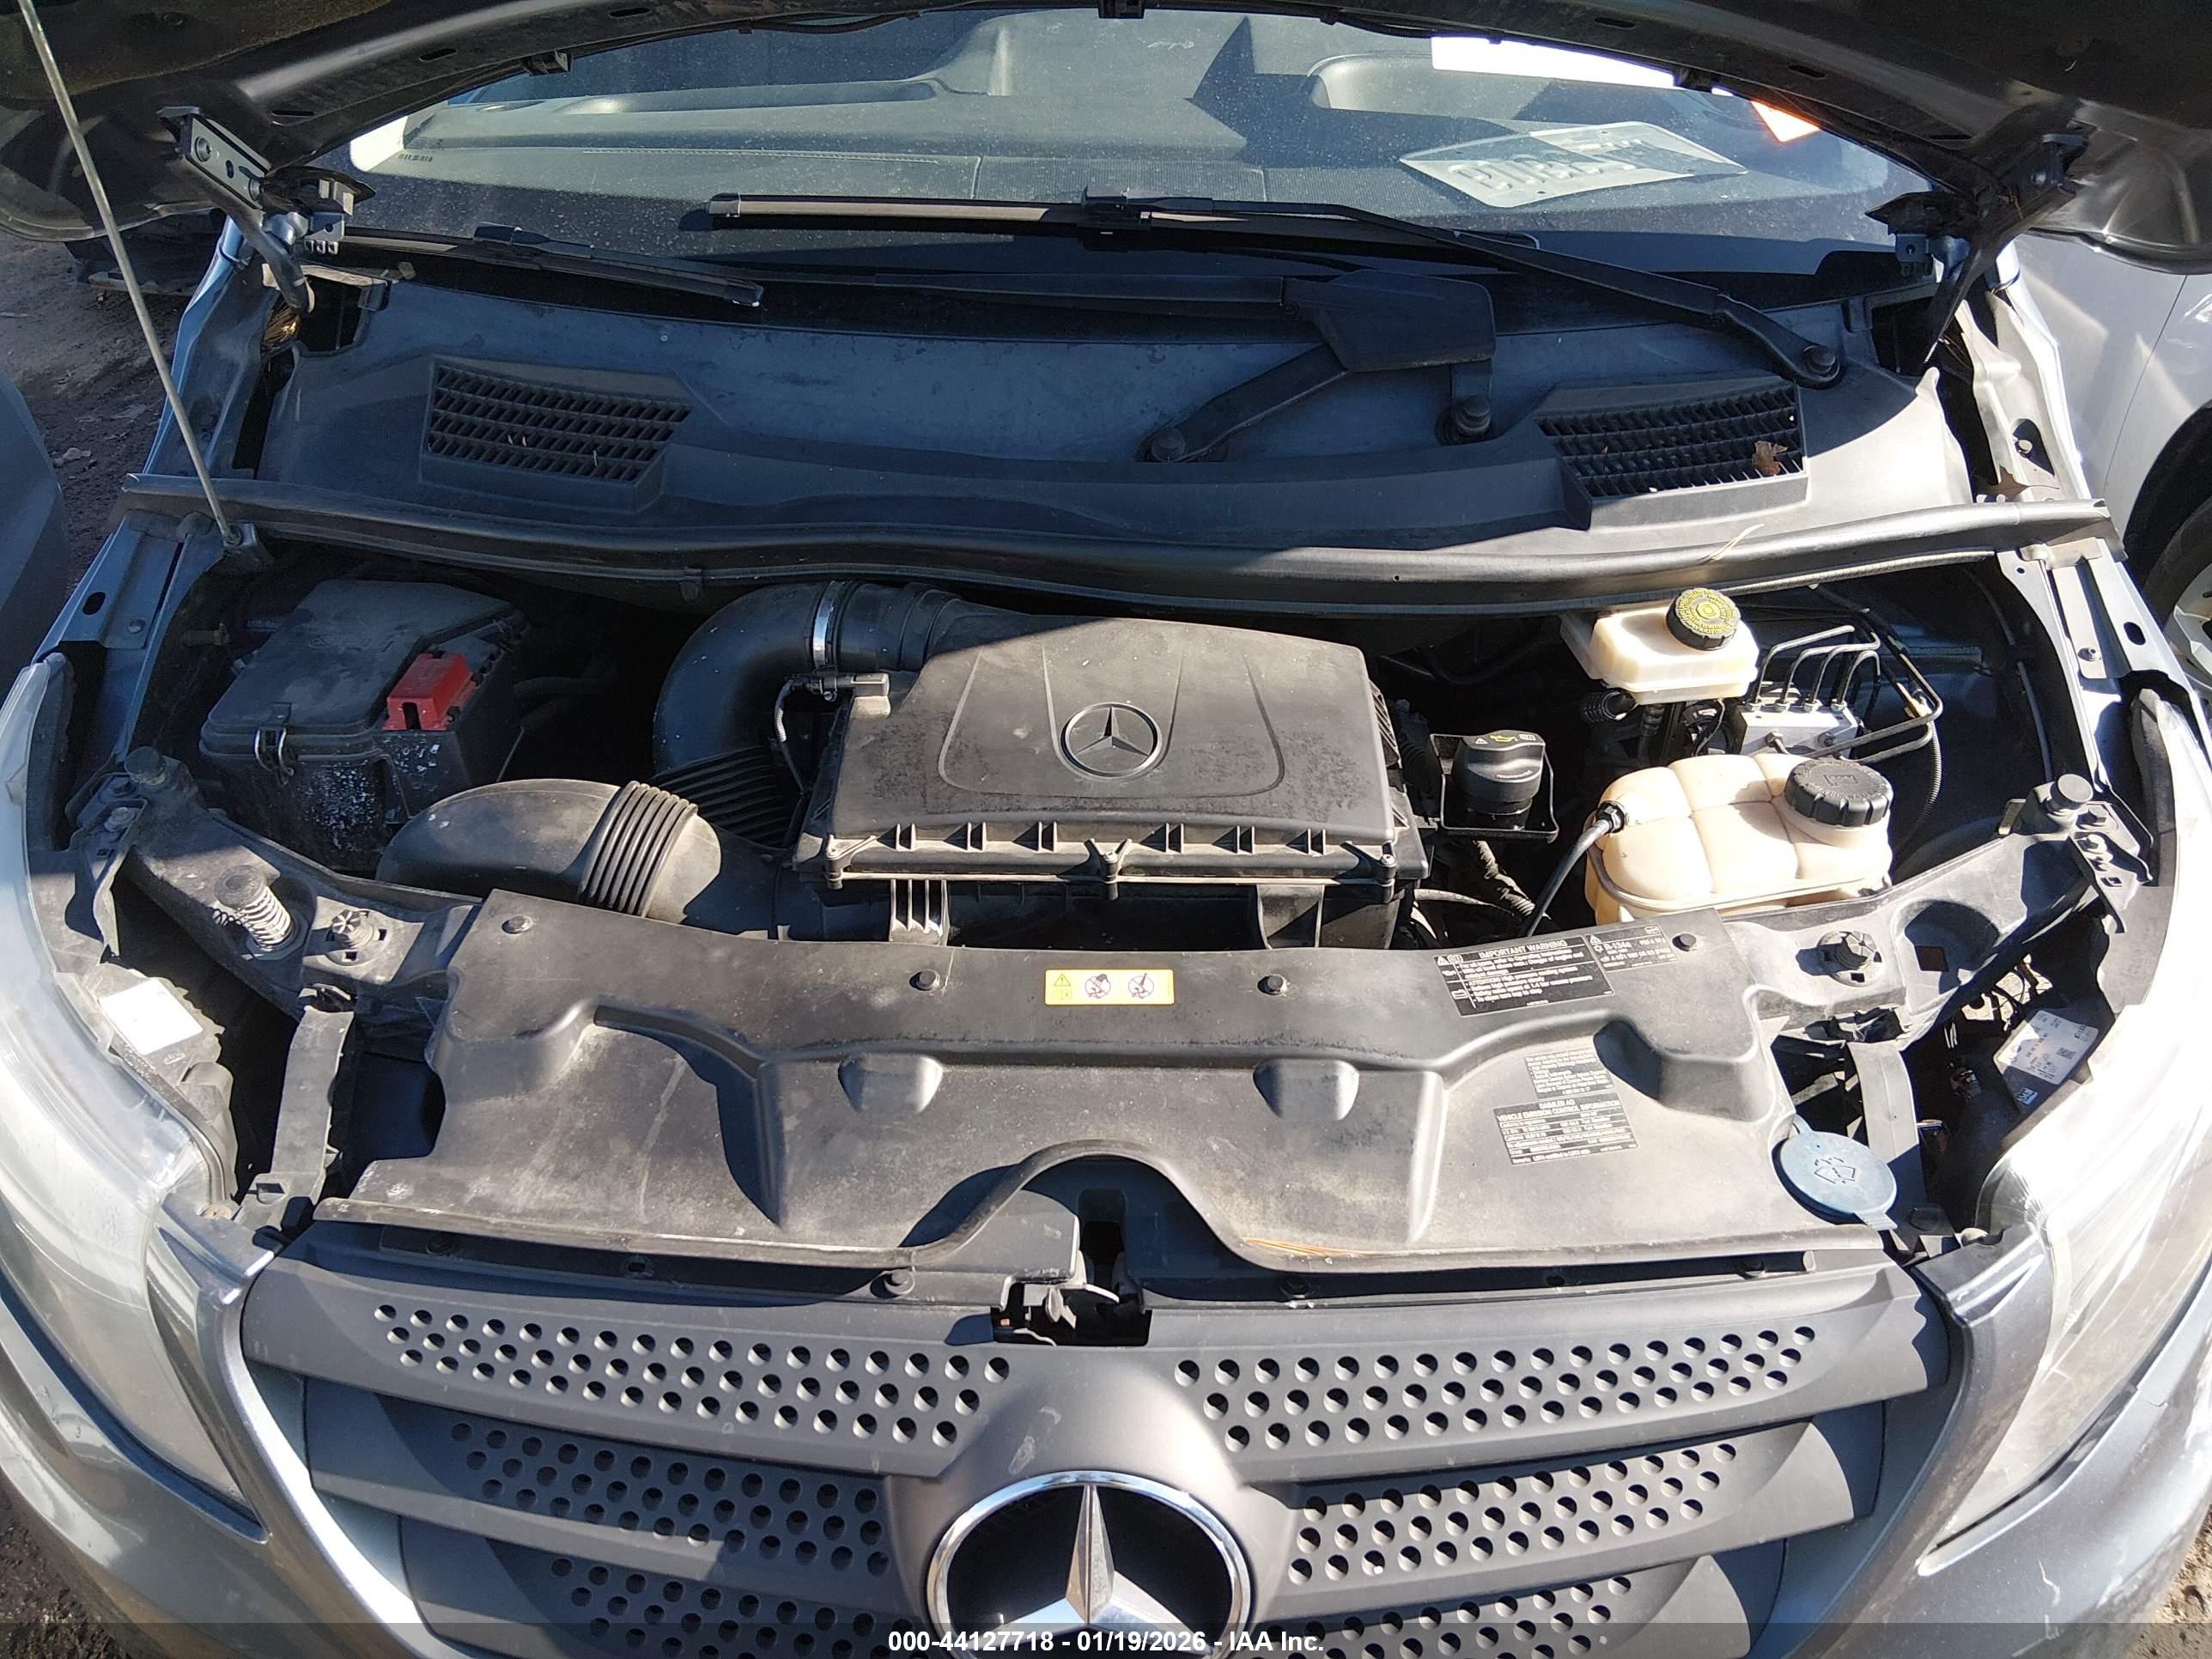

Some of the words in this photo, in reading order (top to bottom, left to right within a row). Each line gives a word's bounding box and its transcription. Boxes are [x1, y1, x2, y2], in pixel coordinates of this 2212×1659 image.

[1478, 945, 1528, 958] IMPORTANT
[1526, 939, 1568, 951] WARNING
[1497, 1113, 1522, 1121] VEHICLE
[1522, 1109, 1552, 1118] EMISSION
[1552, 1105, 1580, 1114] CONTROL
[1579, 1100, 1620, 1110] INFORMATION
[1538, 1100, 1565, 1109] DAIMLER
